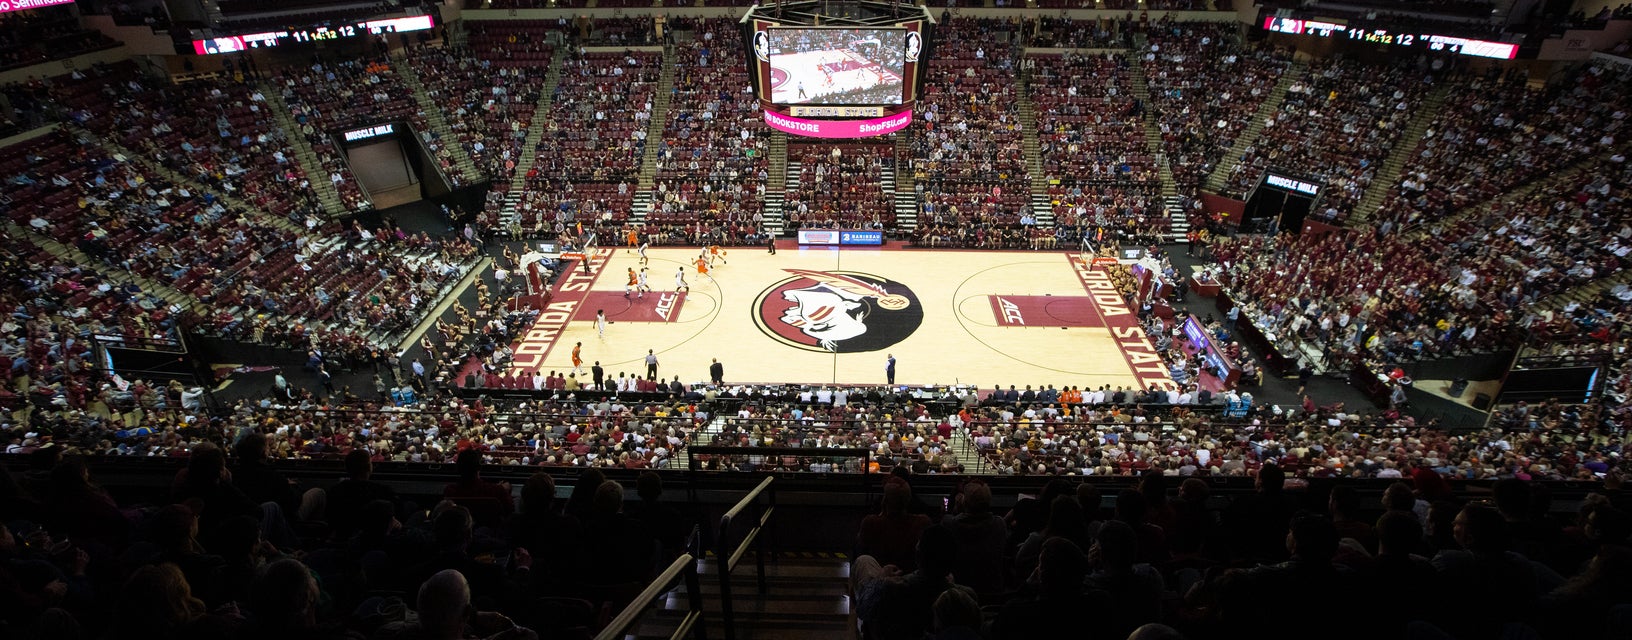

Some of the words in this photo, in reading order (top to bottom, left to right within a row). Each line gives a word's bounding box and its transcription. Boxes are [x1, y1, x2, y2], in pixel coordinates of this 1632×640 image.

[0, 1, 10, 11] o
[293, 31, 309, 42] 11
[339, 25, 355, 37] 12
[1348, 28, 1365, 39] 11
[1365, 33, 1393, 44] 14:12
[1396, 33, 1414, 46] 12
[797, 108, 839, 117] FLORIDA
[845, 108, 878, 117] STATE
[772, 116, 819, 132] BOOKSTORE
[860, 116, 907, 132] ShopFSU.com
[345, 128, 375, 141] MUSCLE
[374, 125, 394, 136] MILK
[1267, 175, 1298, 190] MUSCLE
[1297, 182, 1319, 194] MILK
[655, 292, 675, 320] ACC
[1001, 298, 1024, 325] ACC
[1112, 326, 1180, 393] STATE
